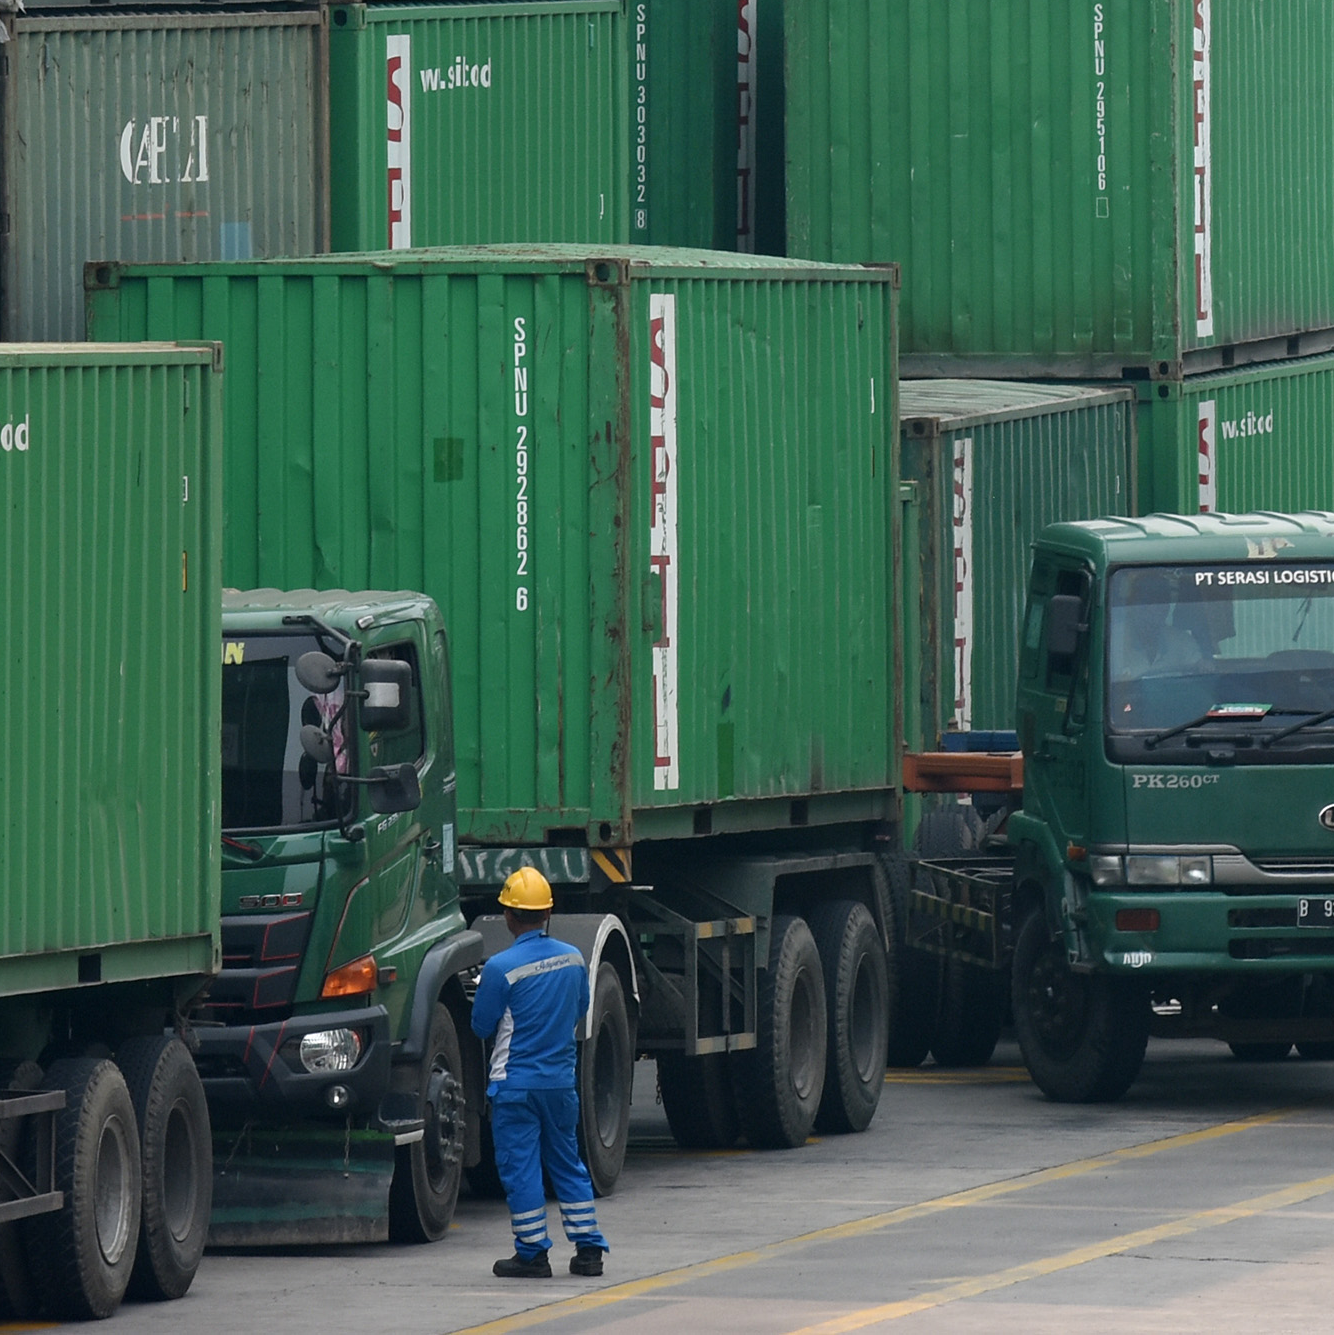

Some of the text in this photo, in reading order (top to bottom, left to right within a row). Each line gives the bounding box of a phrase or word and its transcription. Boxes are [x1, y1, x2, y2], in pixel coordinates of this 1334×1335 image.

[636, 4, 646, 81] SPNU
[1094, 4, 1107, 190] SPNU 295106
[637, 86, 646, 202] 303032
[514, 318, 527, 610] SPNU 292862 6
[1195, 572, 1214, 585] PT
[1217, 571, 1269, 585] SERASI
[239, 893, 303, 908] 500
[1299, 900, 1309, 918] B
